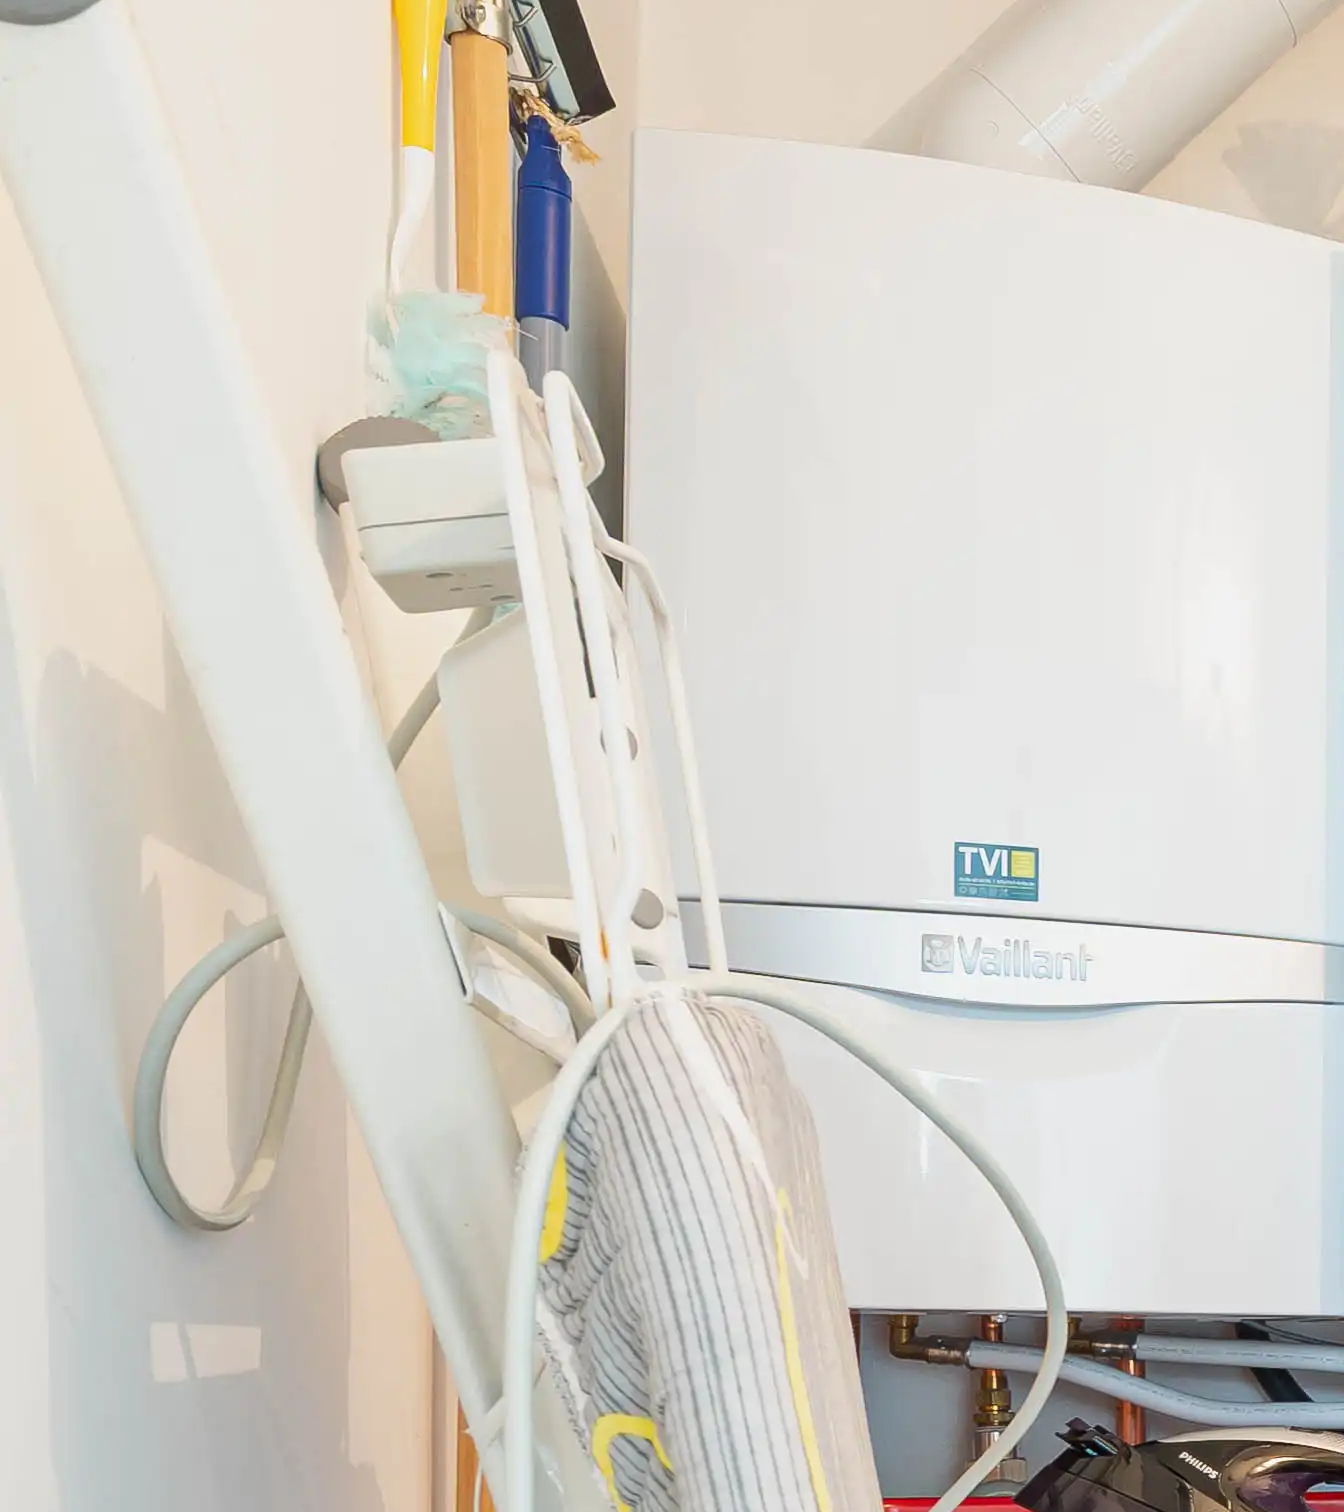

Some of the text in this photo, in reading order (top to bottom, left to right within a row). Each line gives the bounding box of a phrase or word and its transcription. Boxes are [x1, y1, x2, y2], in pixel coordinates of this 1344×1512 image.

[958, 846, 1009, 877] TVI
[957, 935, 1096, 981] Vaillant
[1178, 1451, 1219, 1479] PHILIPS
